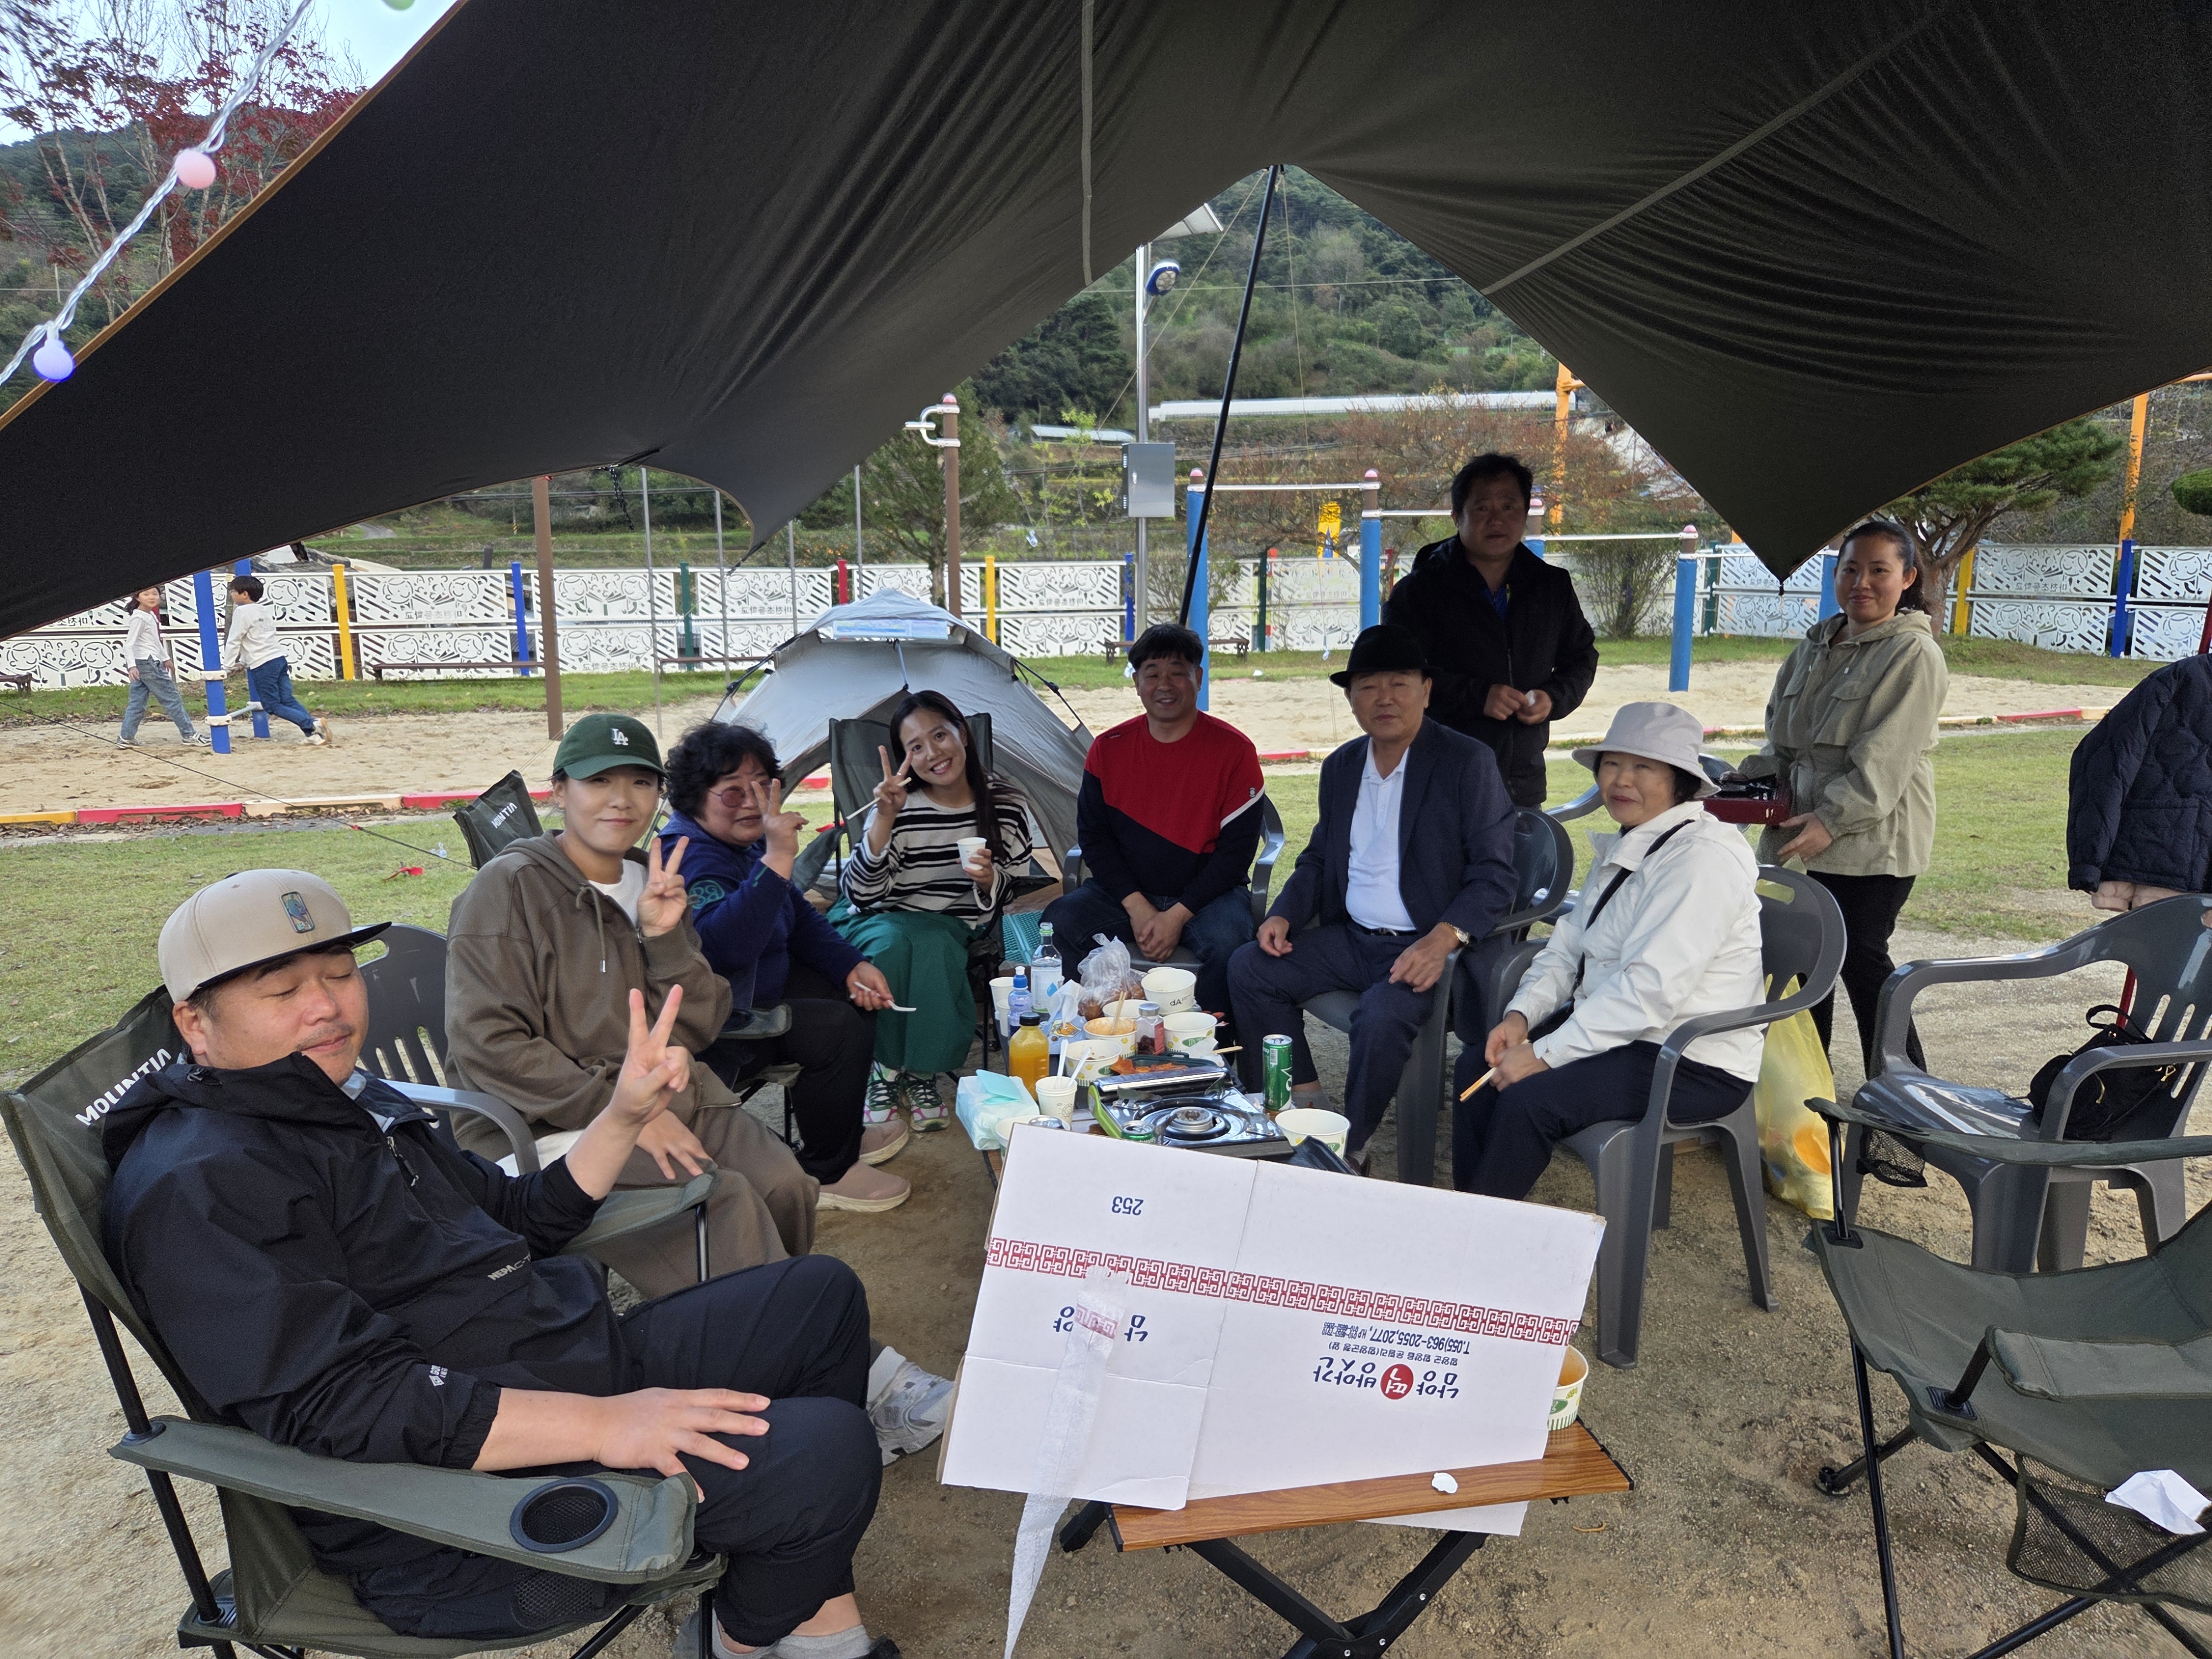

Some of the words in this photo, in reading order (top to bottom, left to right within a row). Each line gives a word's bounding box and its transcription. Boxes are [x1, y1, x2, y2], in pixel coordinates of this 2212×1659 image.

[612, 728, 629, 745] LA
[75, 1048, 172, 1126] MOUNTIA
[1112, 1196, 1144, 1215] 253
[487, 1264, 517, 1281] NEPA
[1328, 1341, 1340, 1350] 앞)
[1407, 1352, 1431, 1363] 함양읍
[1433, 1355, 1458, 1366] 함양군
[1313, 1357, 1377, 1388] 방앗간
[1385, 1368, 1408, 1394] 떡
[1416, 1370, 1459, 1399] 남양
